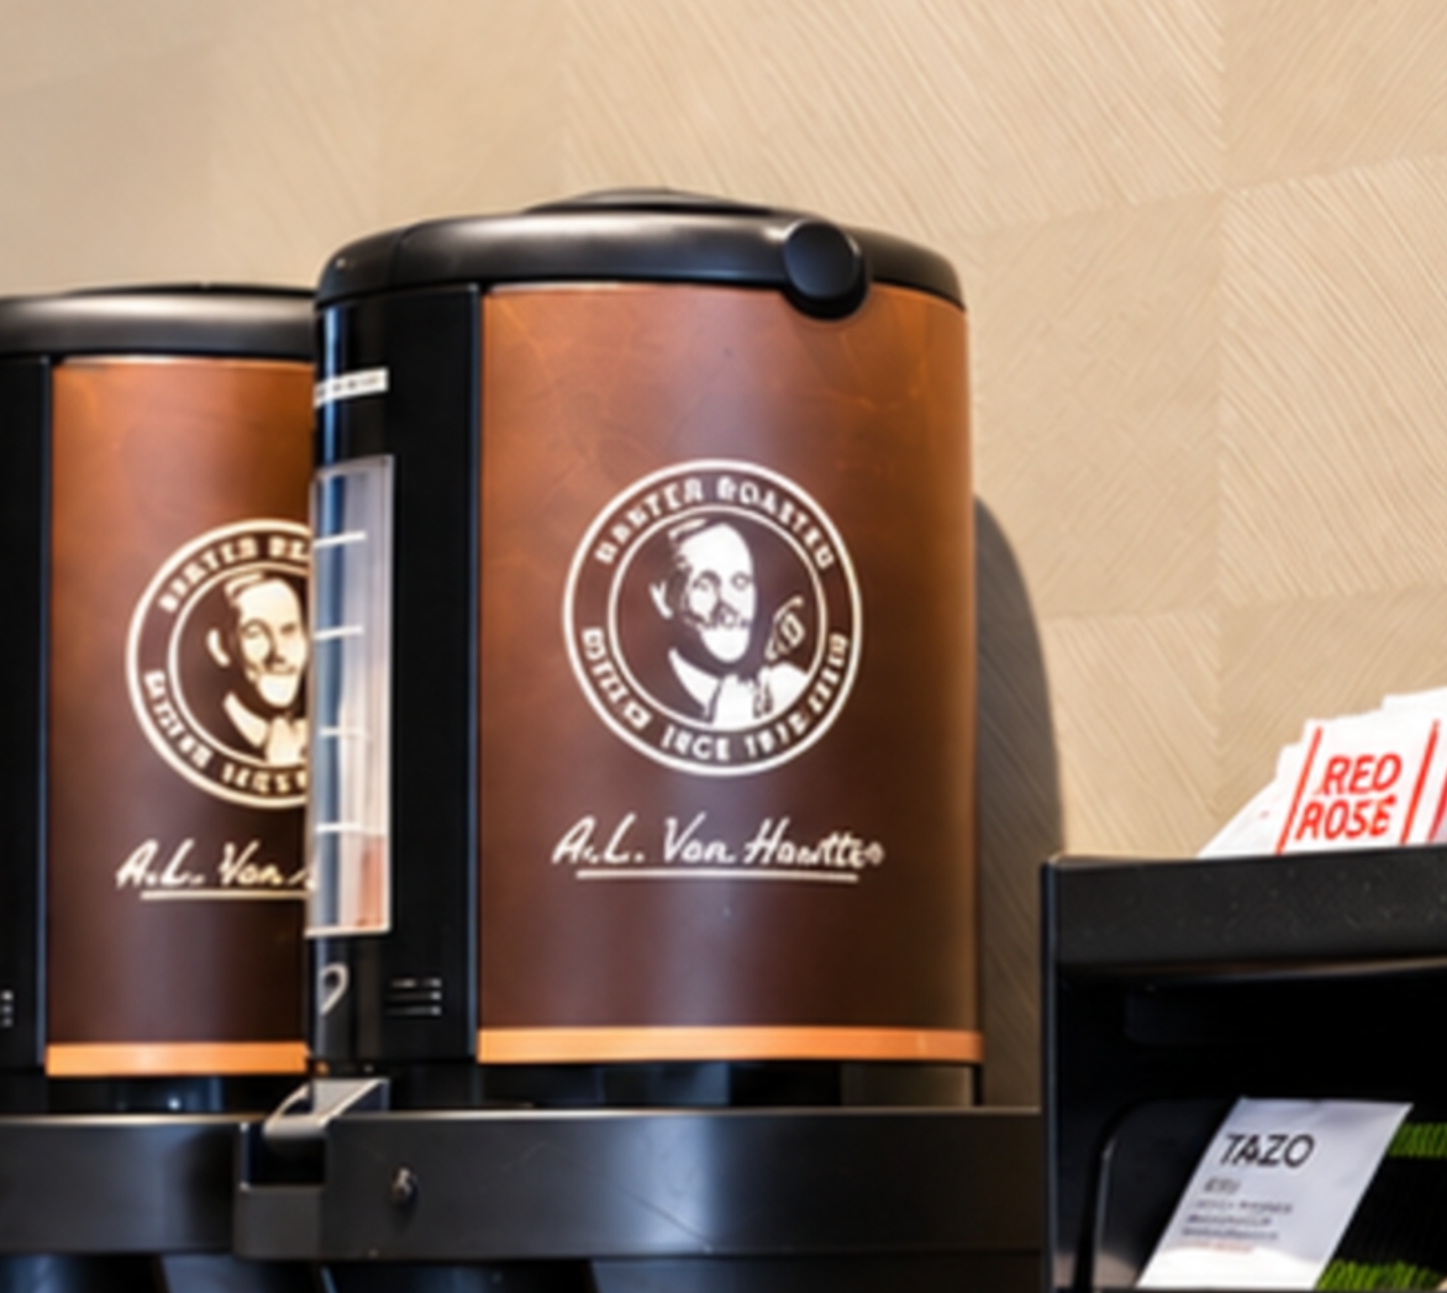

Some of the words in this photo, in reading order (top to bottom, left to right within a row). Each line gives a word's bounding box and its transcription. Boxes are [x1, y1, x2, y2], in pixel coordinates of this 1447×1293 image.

[1321, 752, 1403, 797] RED
[551, 812, 646, 864] A.L.
[664, 810, 737, 864] Van
[1295, 795, 1398, 842] ROSE
[1219, 1132, 1316, 1169] TAZO
